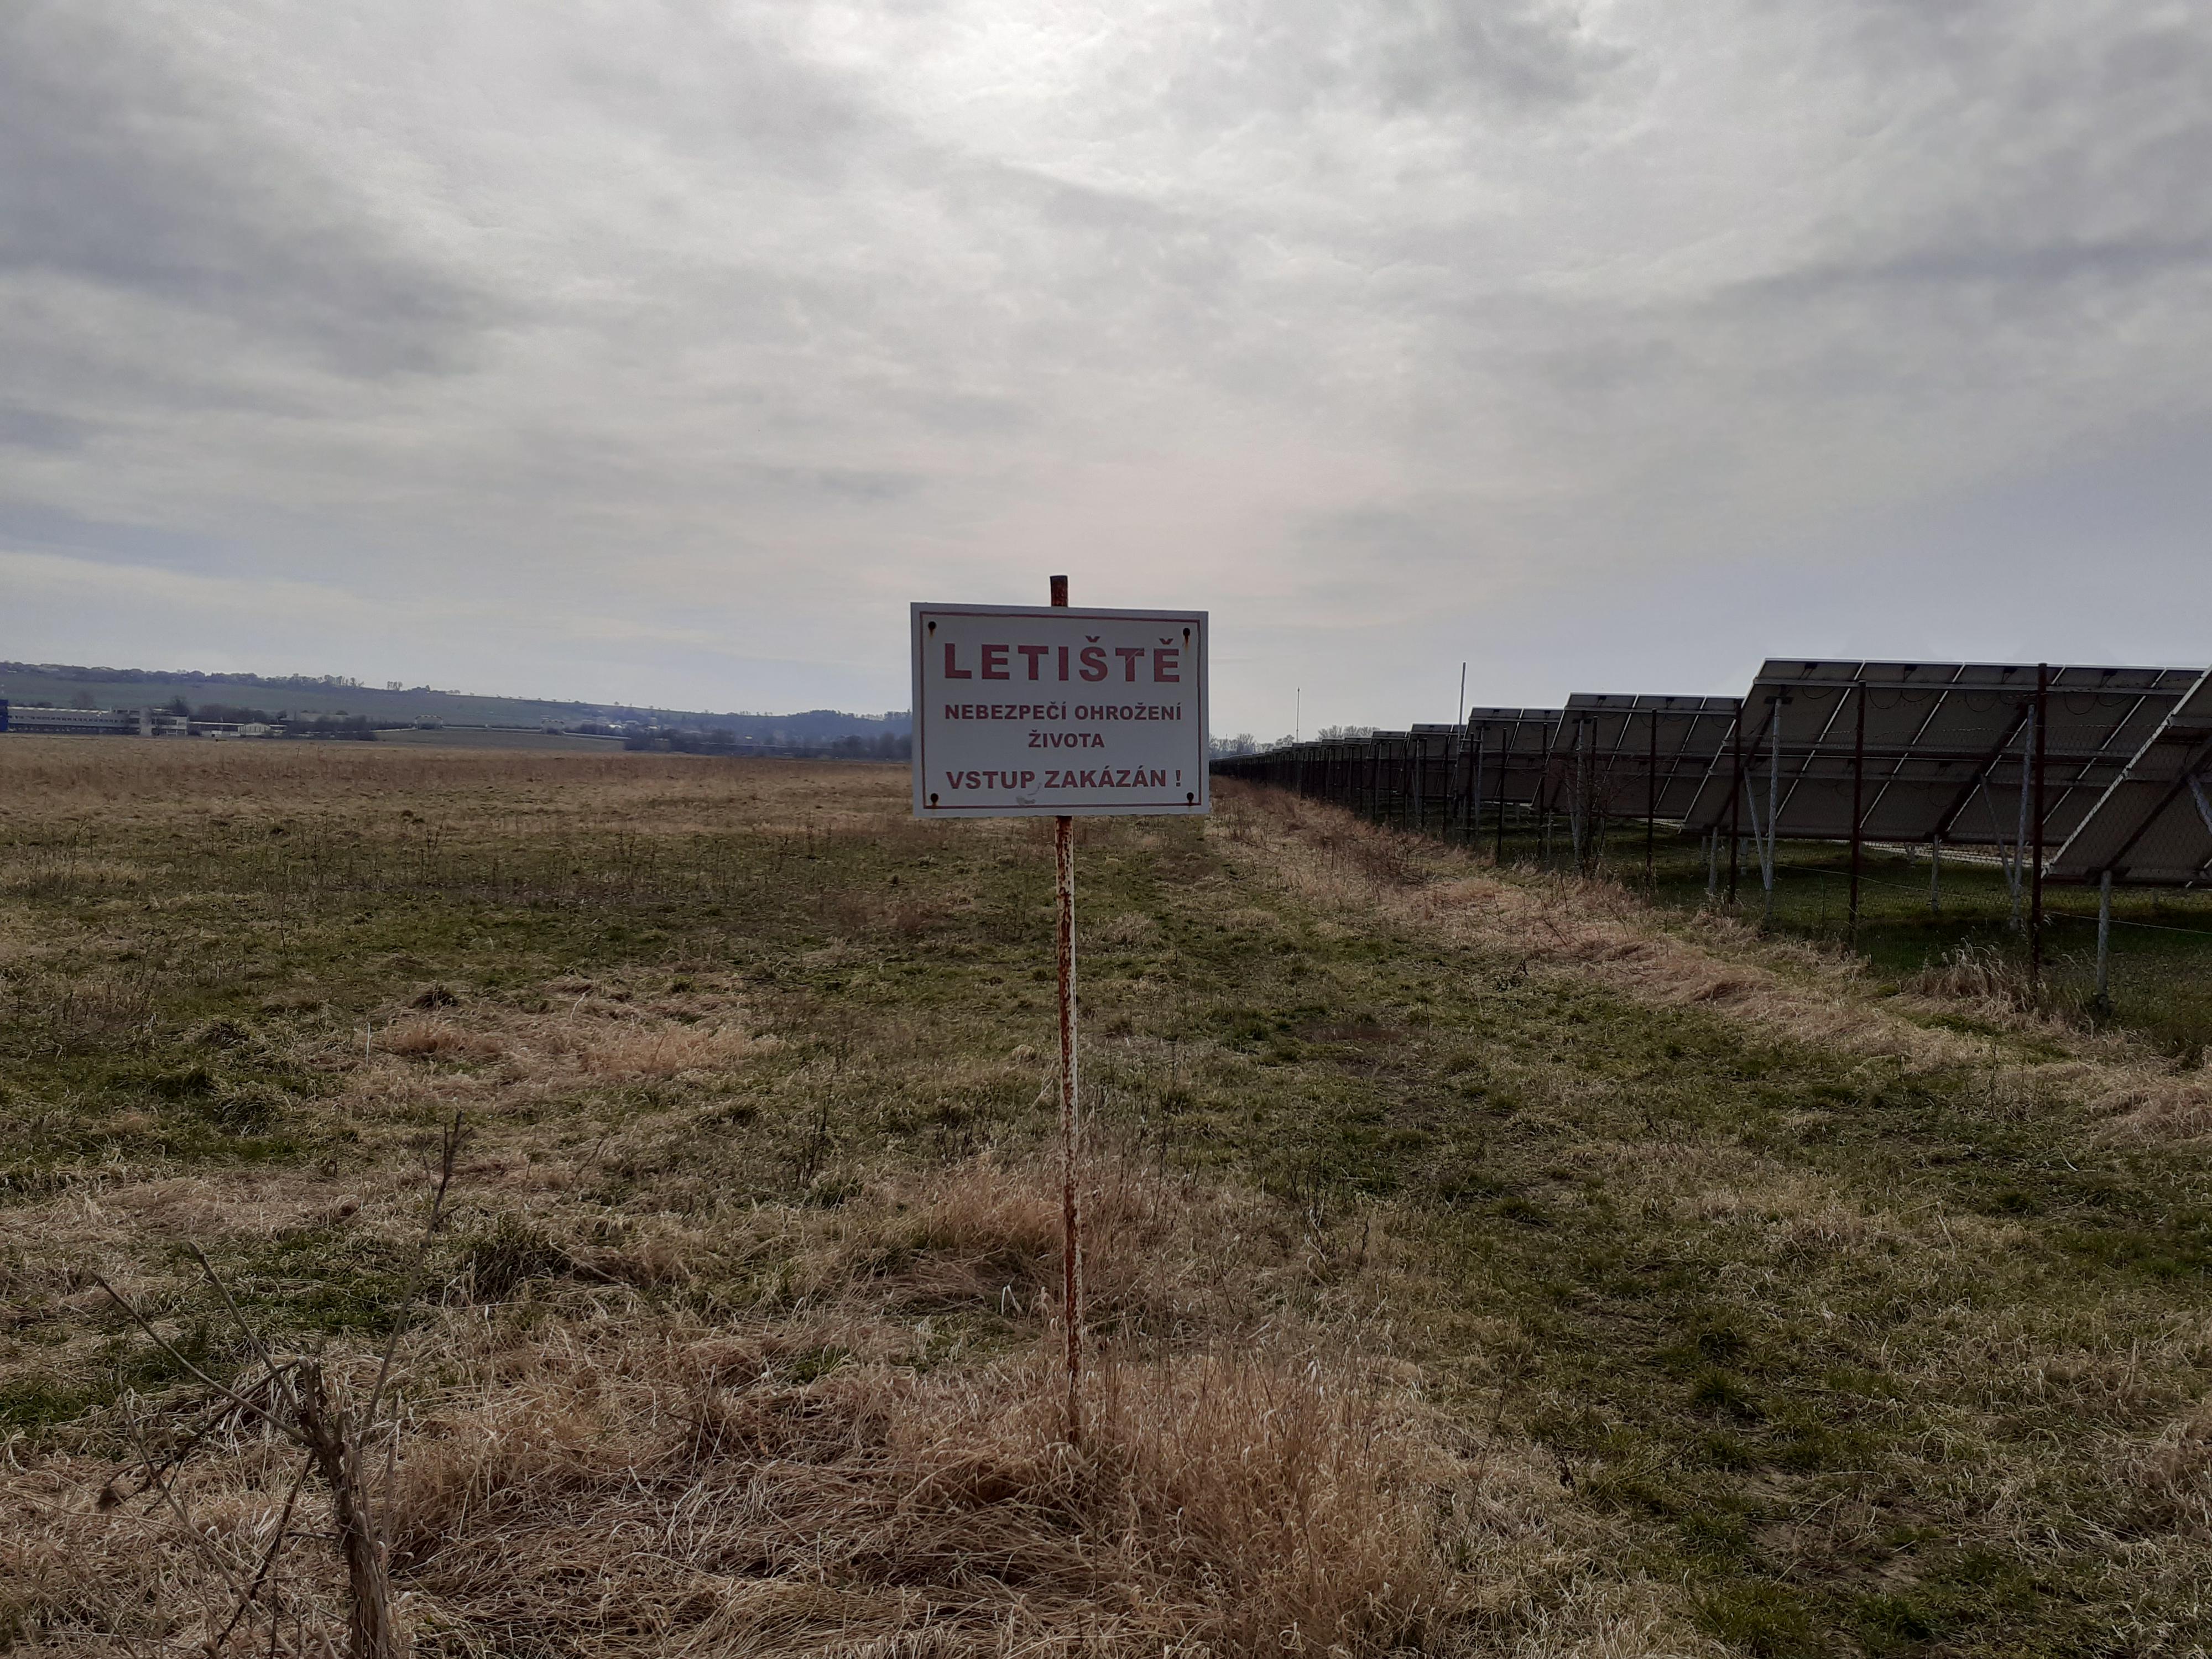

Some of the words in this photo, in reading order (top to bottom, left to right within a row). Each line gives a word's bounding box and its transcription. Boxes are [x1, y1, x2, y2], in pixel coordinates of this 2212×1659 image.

[944, 635, 1180, 683] LETIŠTĚ
[945, 701, 1067, 720] NEBEZPEČÍ
[1074, 702, 1182, 721] OHROŽENÍ
[1027, 729, 1105, 748] ŽIVOTA
[946, 770, 1036, 789] VSTUP
[1044, 765, 1167, 789] ZAKÁZÁN
[1175, 769, 1181, 787] !
